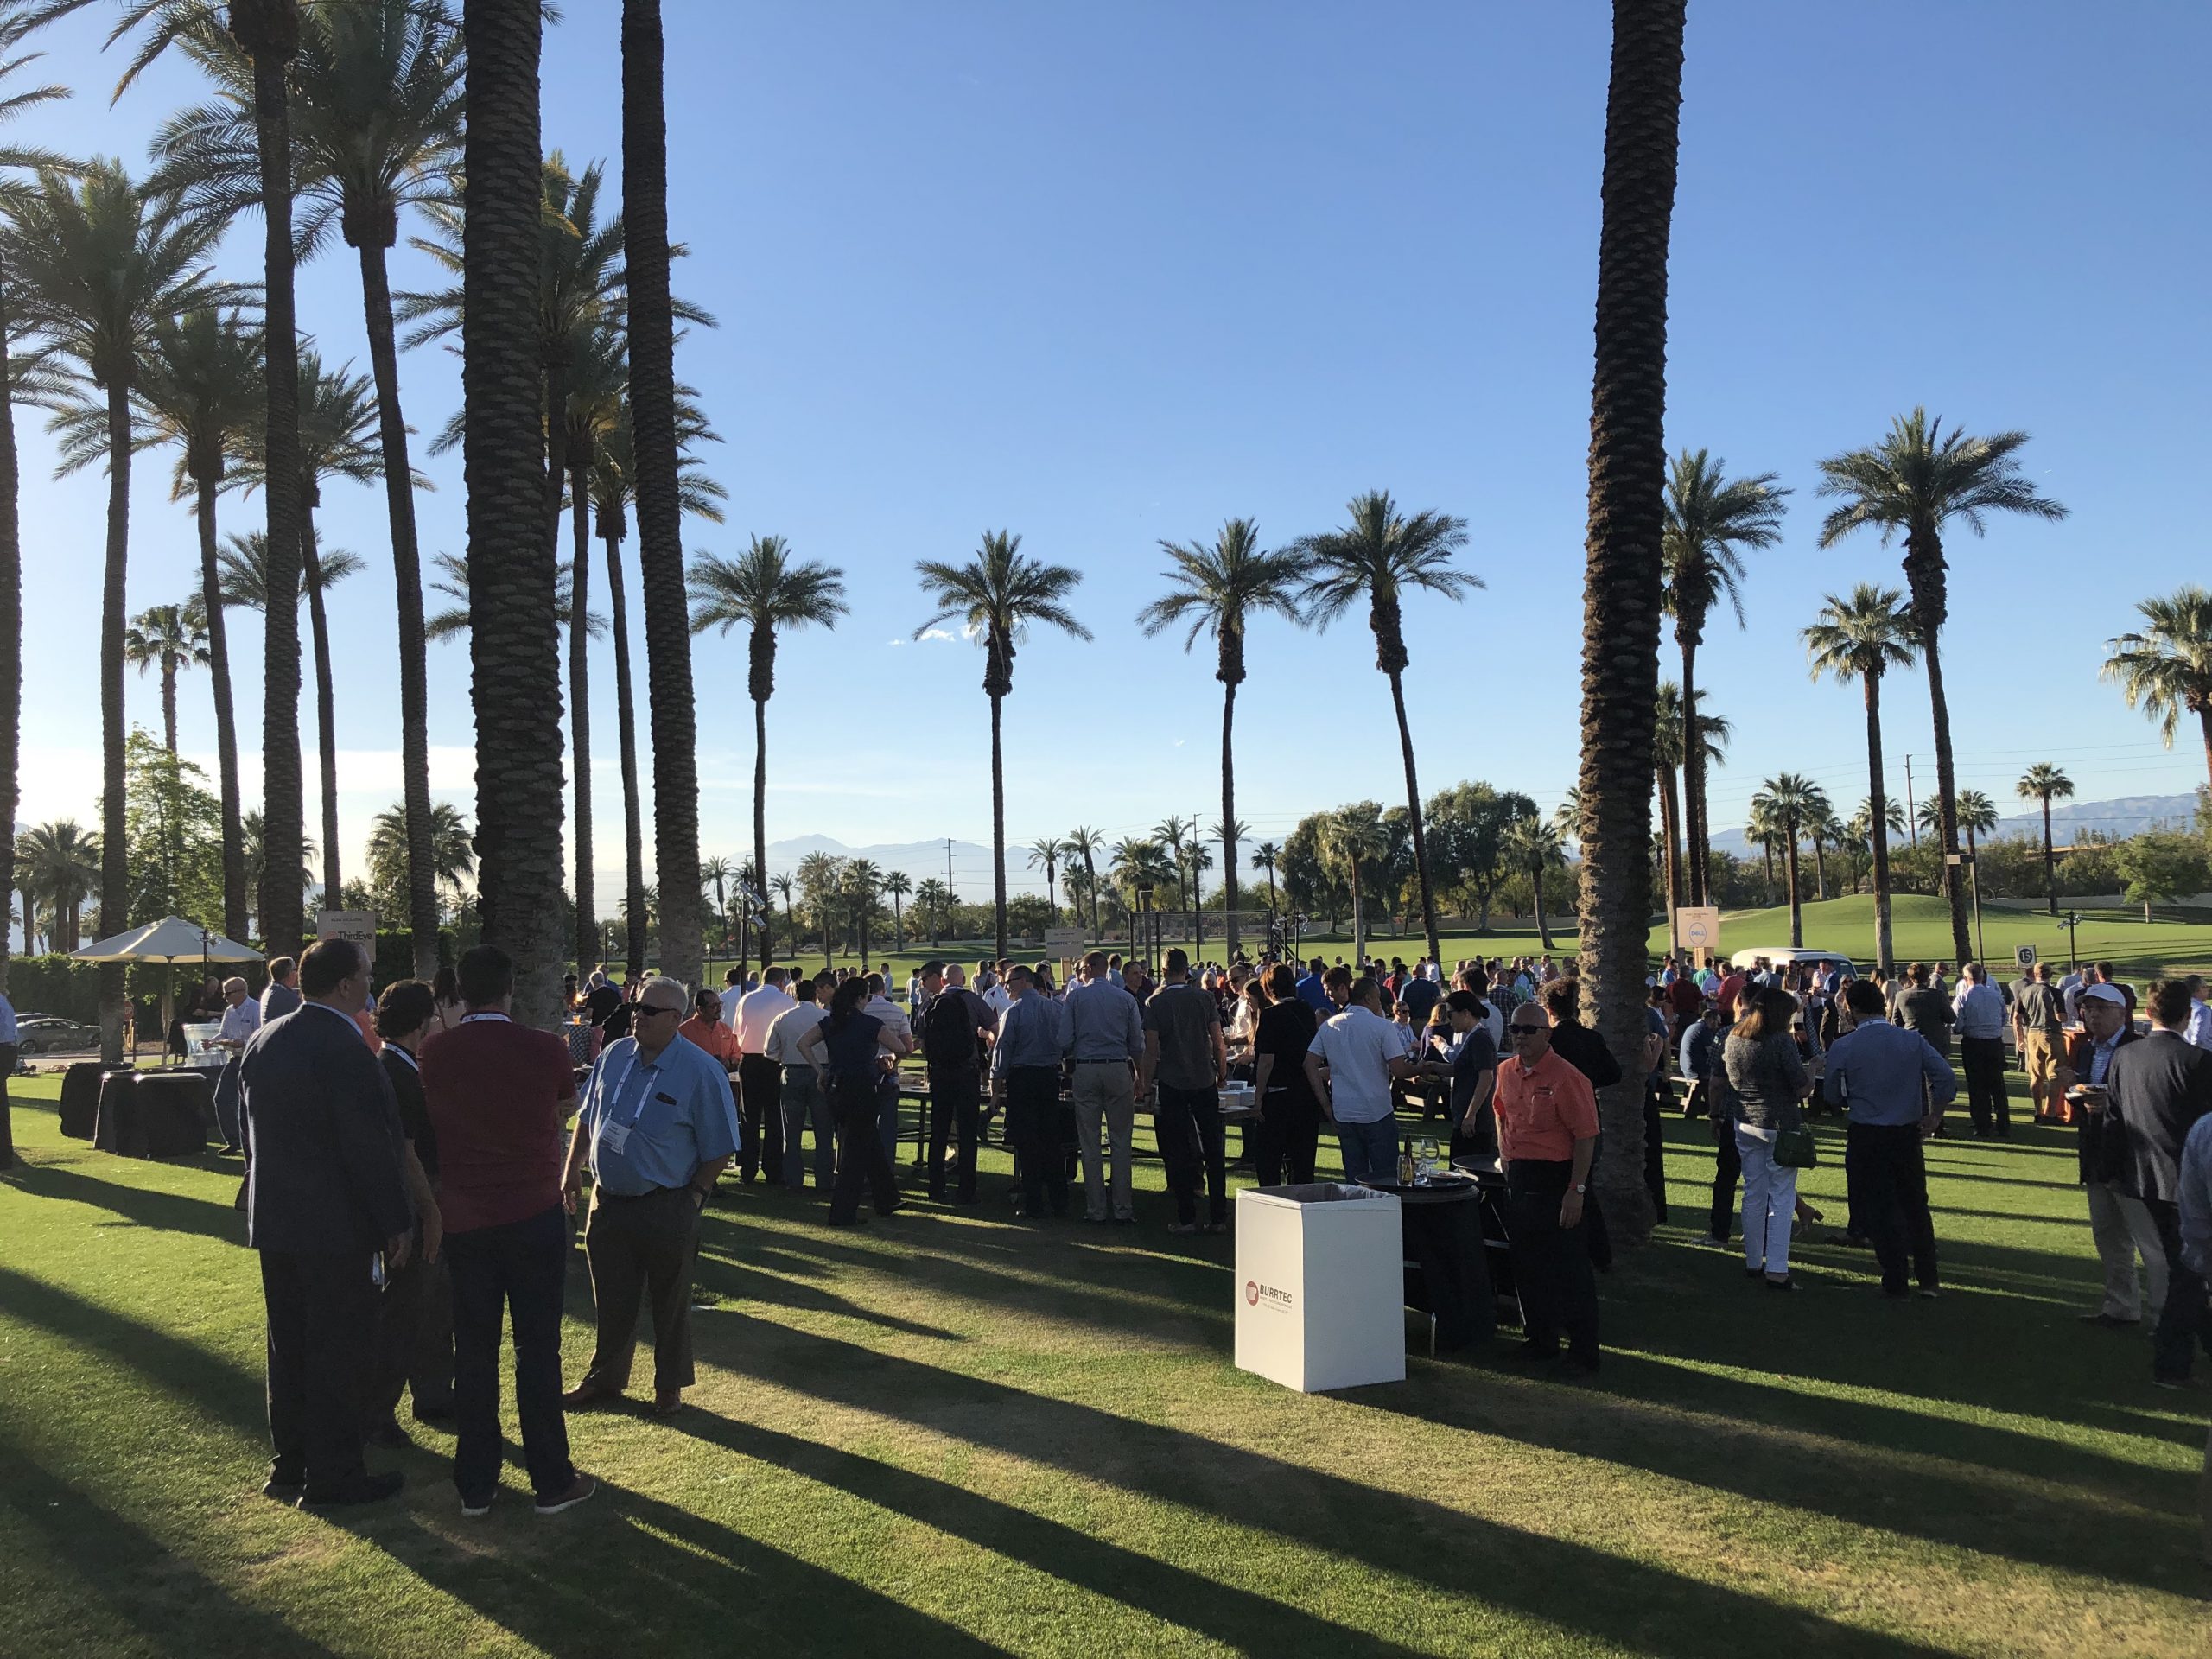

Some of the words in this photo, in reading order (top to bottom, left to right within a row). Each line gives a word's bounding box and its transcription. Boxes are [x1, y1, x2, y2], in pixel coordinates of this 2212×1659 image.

[338, 931, 372, 941] ThirdEye
[2021, 951, 2031, 961] 15
[1260, 1284, 1293, 1304] BURRTEC
